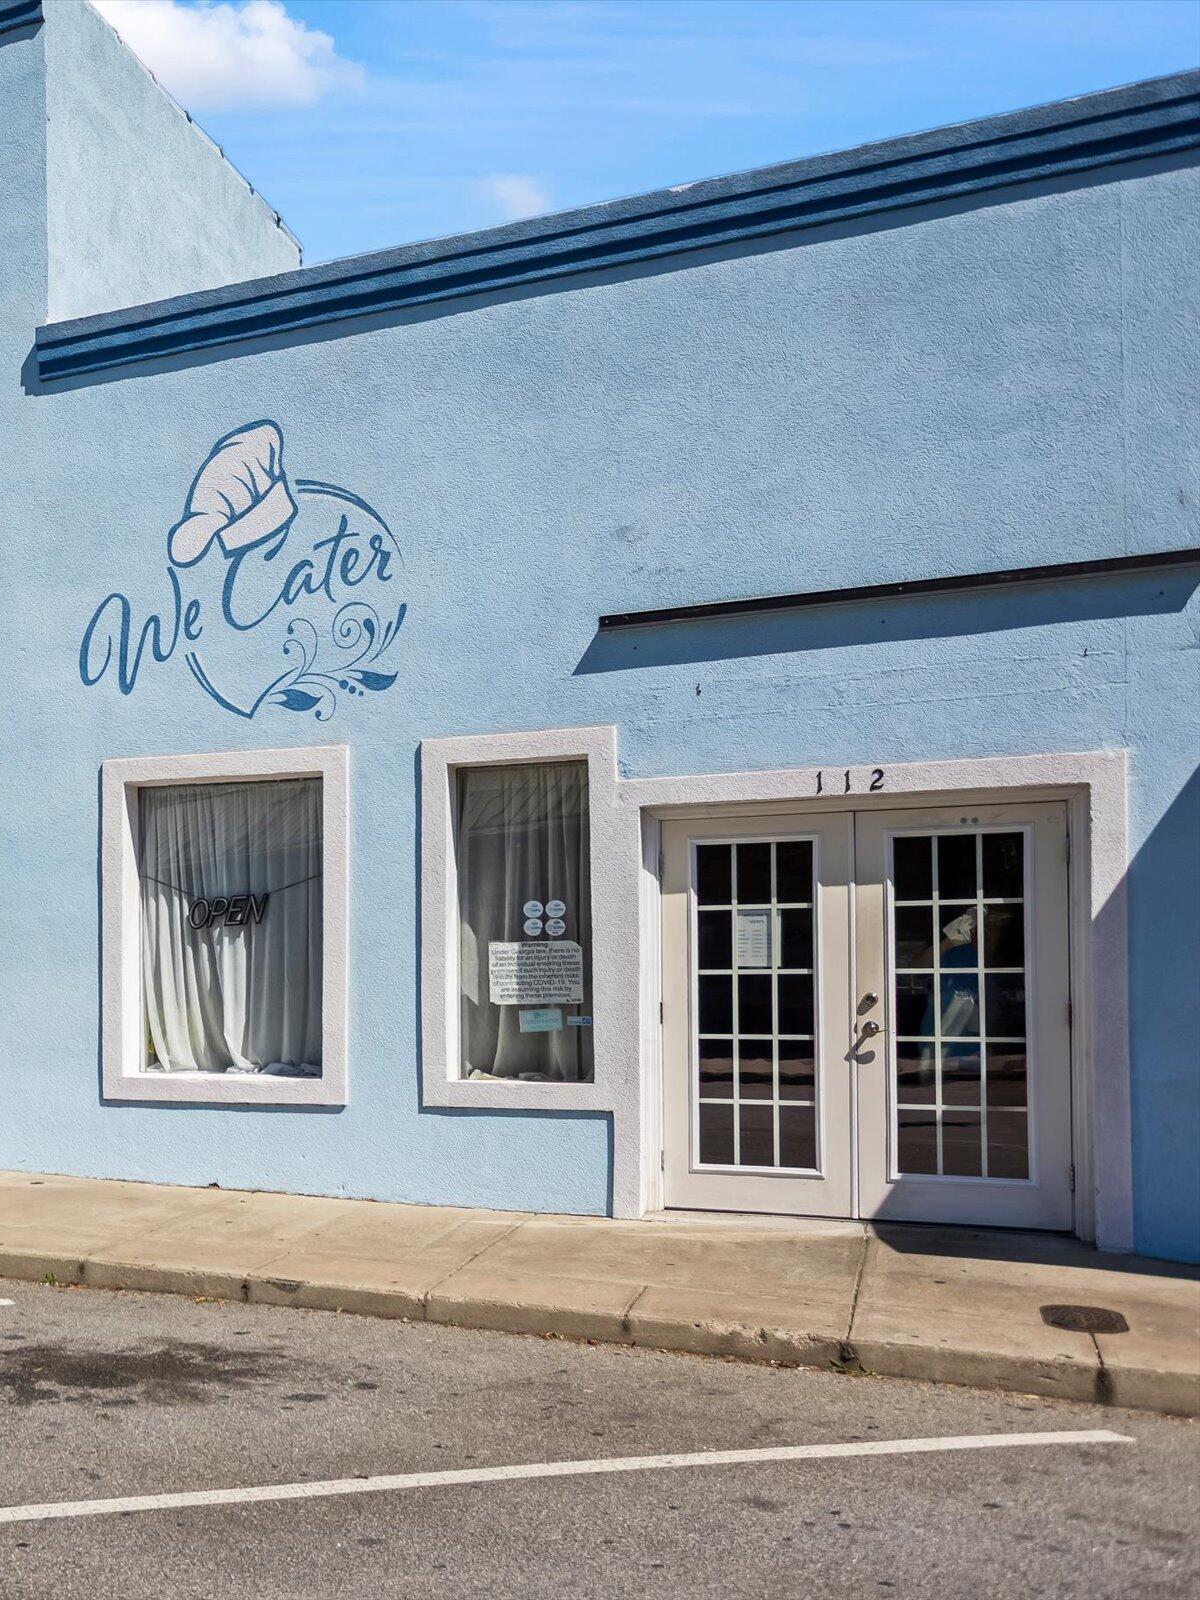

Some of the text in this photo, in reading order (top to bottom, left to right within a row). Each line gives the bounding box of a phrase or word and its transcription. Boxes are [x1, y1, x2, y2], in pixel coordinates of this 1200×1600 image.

[78, 513, 394, 696] We Cater
[816, 768, 884, 795] 112
[187, 893, 270, 930] OPEN
